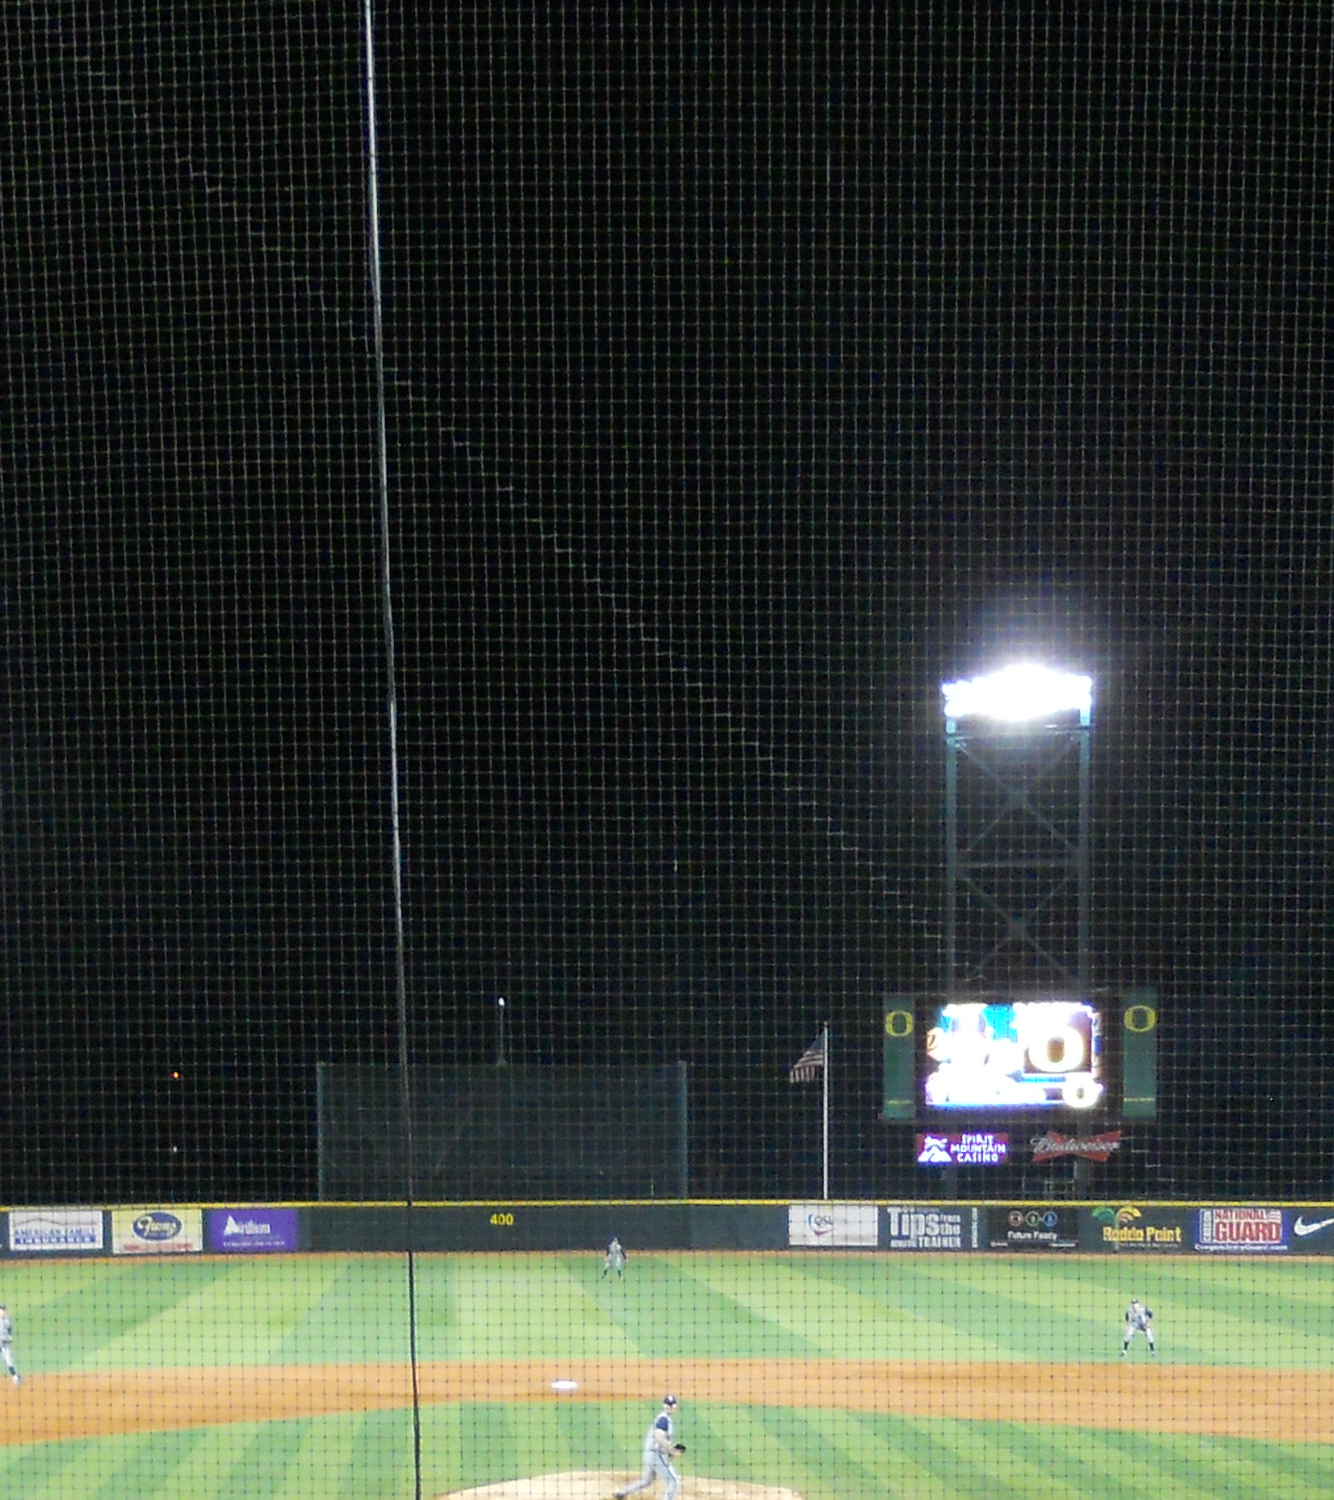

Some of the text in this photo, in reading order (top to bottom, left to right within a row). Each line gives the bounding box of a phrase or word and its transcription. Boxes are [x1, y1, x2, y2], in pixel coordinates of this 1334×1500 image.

[885, 1010, 913, 1037] O
[1123, 1005, 1157, 1033] O
[961, 1134, 995, 1145] SPIRIT
[950, 1143, 1007, 1154] MOUNTAIN
[956, 1153, 999, 1163] CASINO
[490, 1214, 514, 1226] 400
[1214, 1209, 1267, 1221] NATIONAL
[887, 1208, 940, 1240] Tips
[1146, 1227, 1182, 1242] Paint
[1214, 1221, 1281, 1242] GUARD
[919, 1236, 961, 1248] TRAINER
